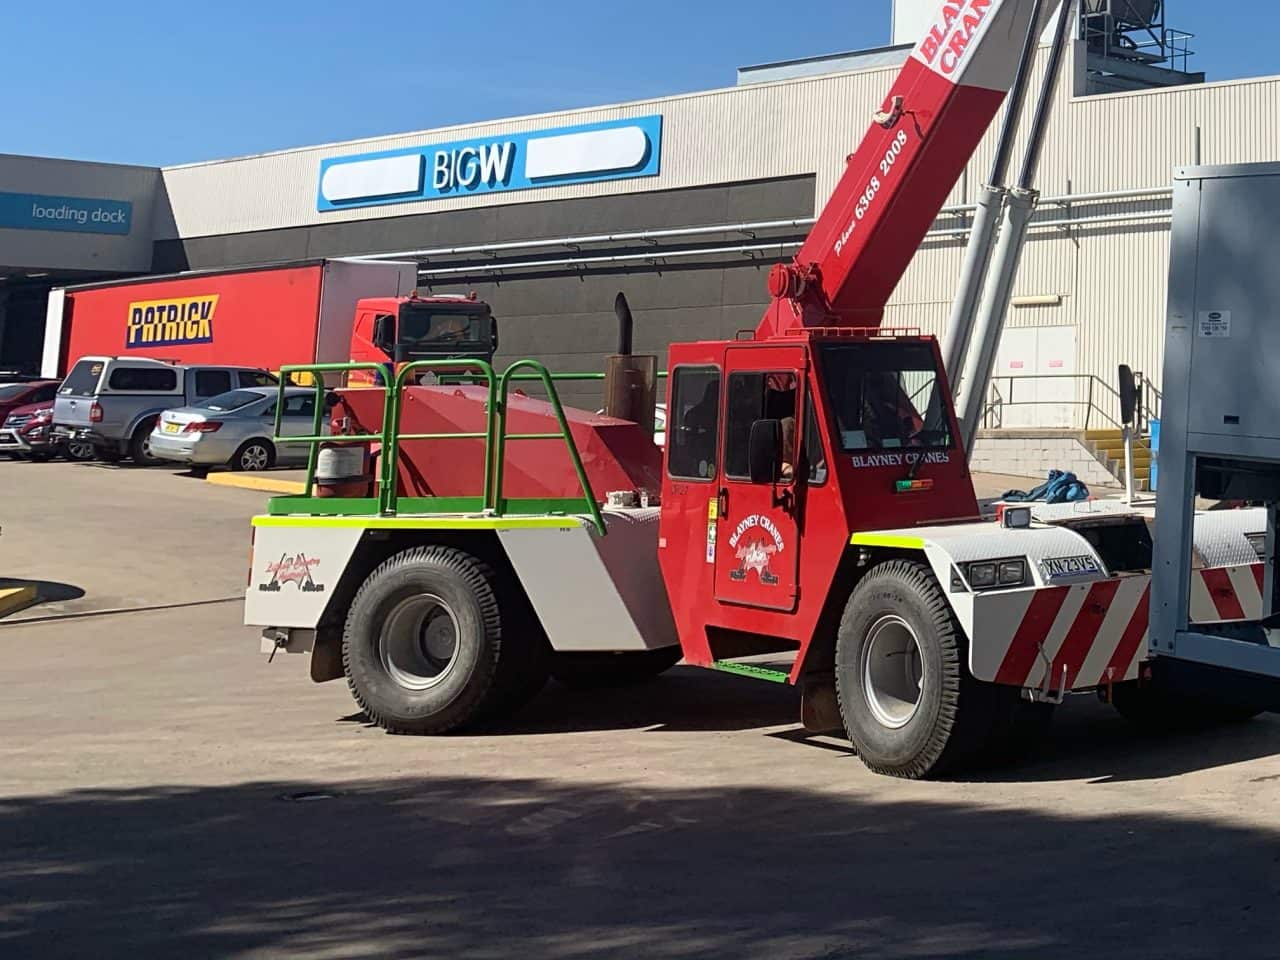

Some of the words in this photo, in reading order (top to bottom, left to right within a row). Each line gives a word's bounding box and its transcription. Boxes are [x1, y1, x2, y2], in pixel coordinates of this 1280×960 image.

[855, 175, 880, 220] 6368
[879, 129, 907, 176] 2008
[32, 202, 88, 224] loading
[91, 207, 126, 223] dock
[127, 300, 213, 344] PATRICK
[851, 453, 903, 468] BLAYNEY
[728, 514, 760, 548] BLAYNEY
[759, 515, 785, 553] CRANES
